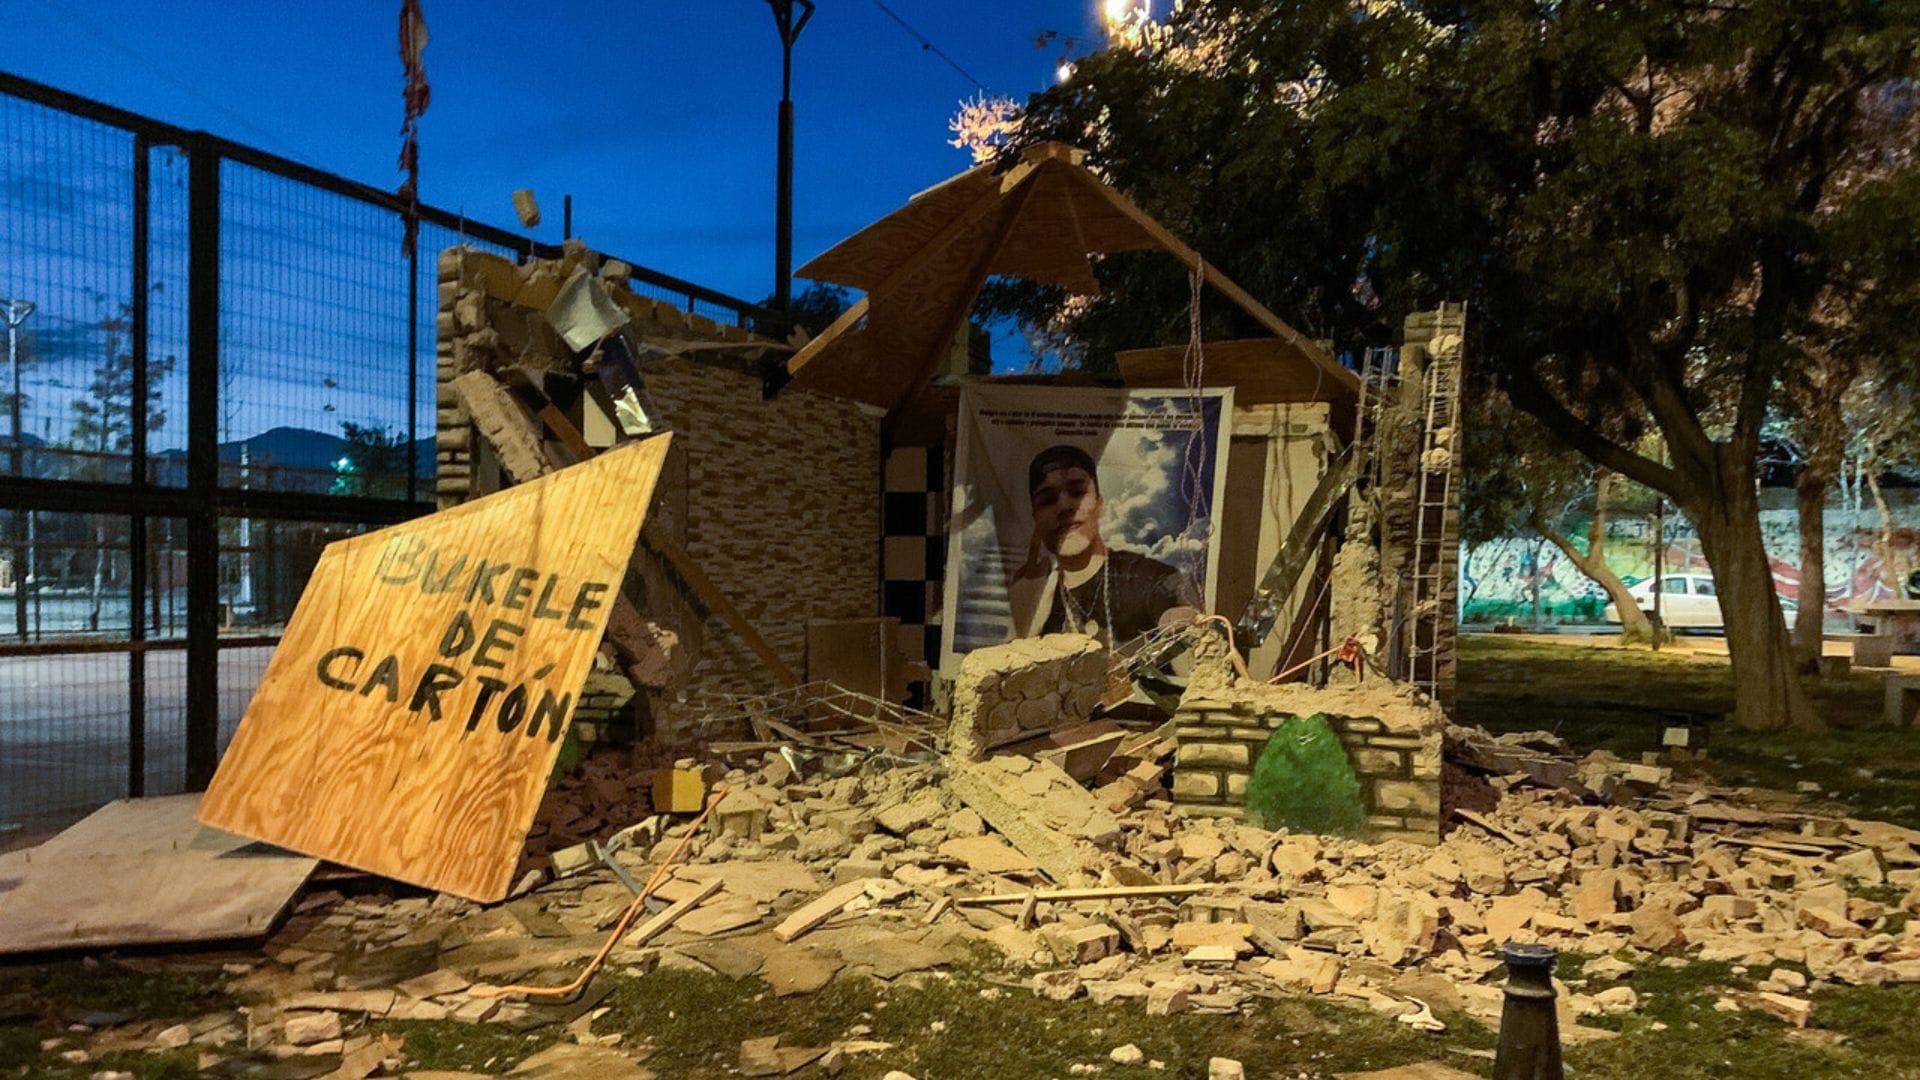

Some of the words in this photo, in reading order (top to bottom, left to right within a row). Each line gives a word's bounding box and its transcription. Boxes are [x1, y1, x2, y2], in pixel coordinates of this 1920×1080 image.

[376, 533, 609, 631] BUKELE
[439, 609, 525, 670] DE
[316, 645, 572, 743] CARTÓN
